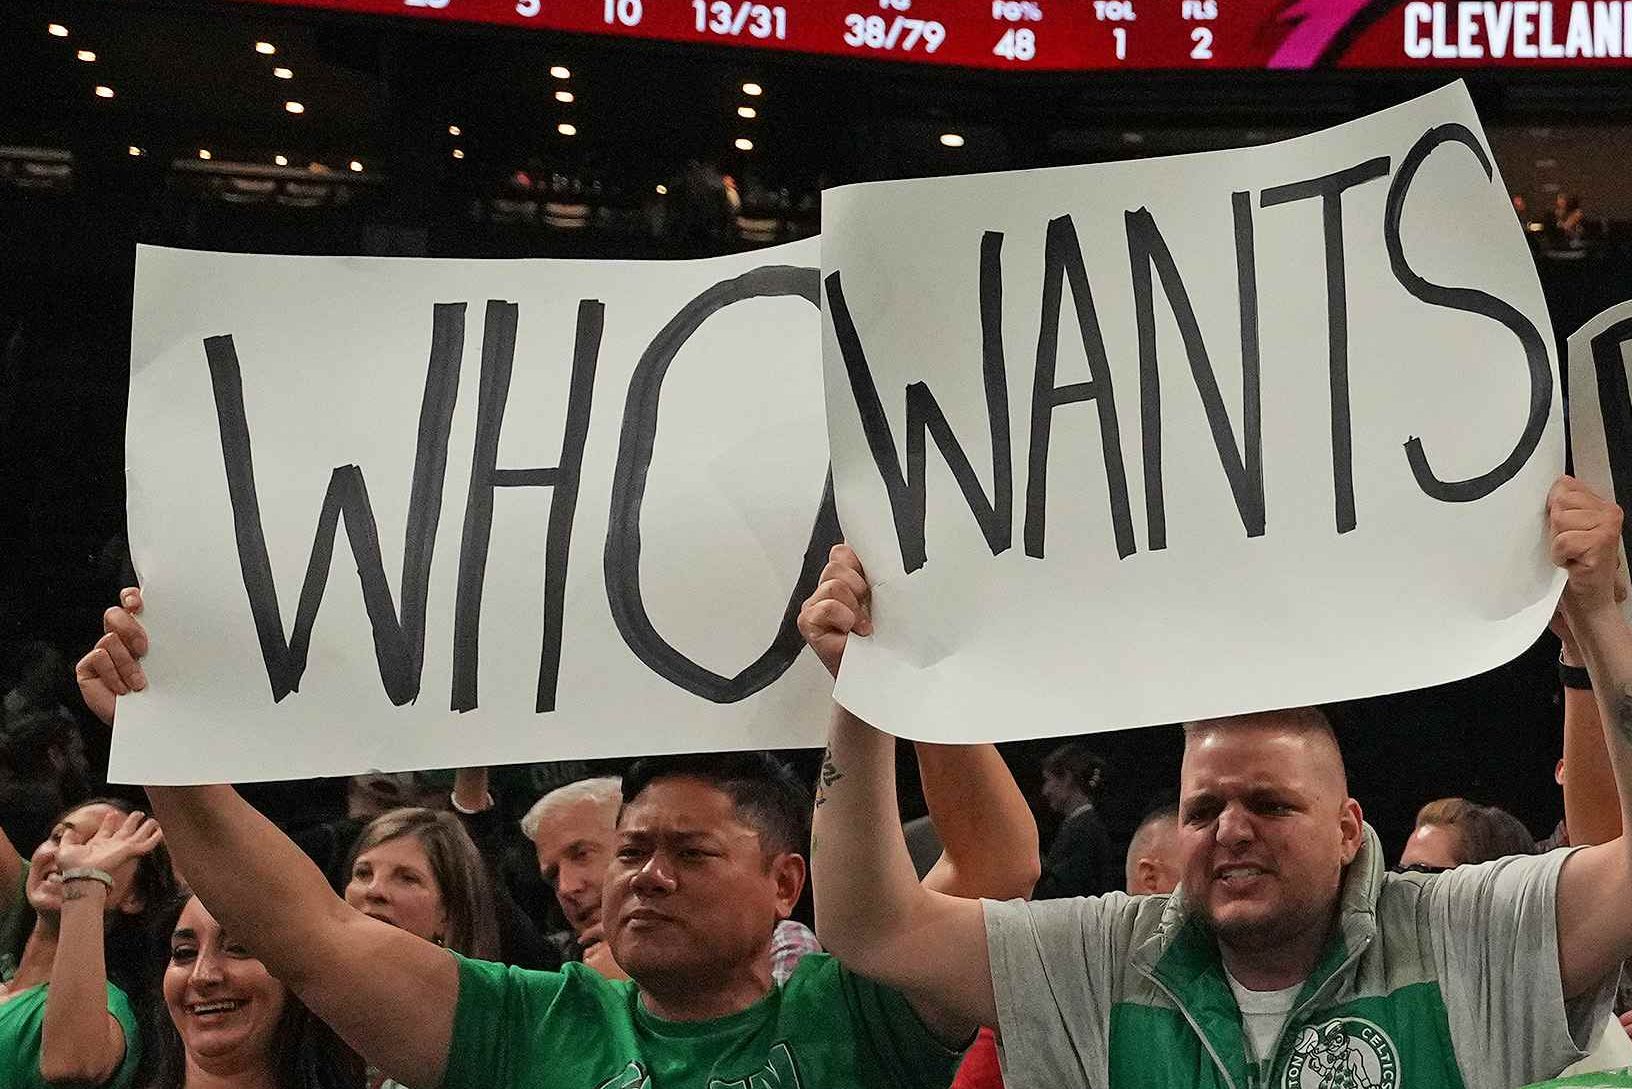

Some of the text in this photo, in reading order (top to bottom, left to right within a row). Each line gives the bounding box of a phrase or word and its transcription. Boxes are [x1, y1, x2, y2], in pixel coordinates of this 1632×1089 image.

[603, 0, 643, 27] 10
[692, 0, 787, 40] 13/31
[843, 13, 946, 54] 38/79
[993, 28, 1036, 61] 48
[1112, 28, 1127, 60] 1
[1190, 27, 1214, 60] 2
[1093, 0, 1137, 21] TOL
[823, 122, 1554, 575] WANTS
[203, 265, 845, 714] WHO
